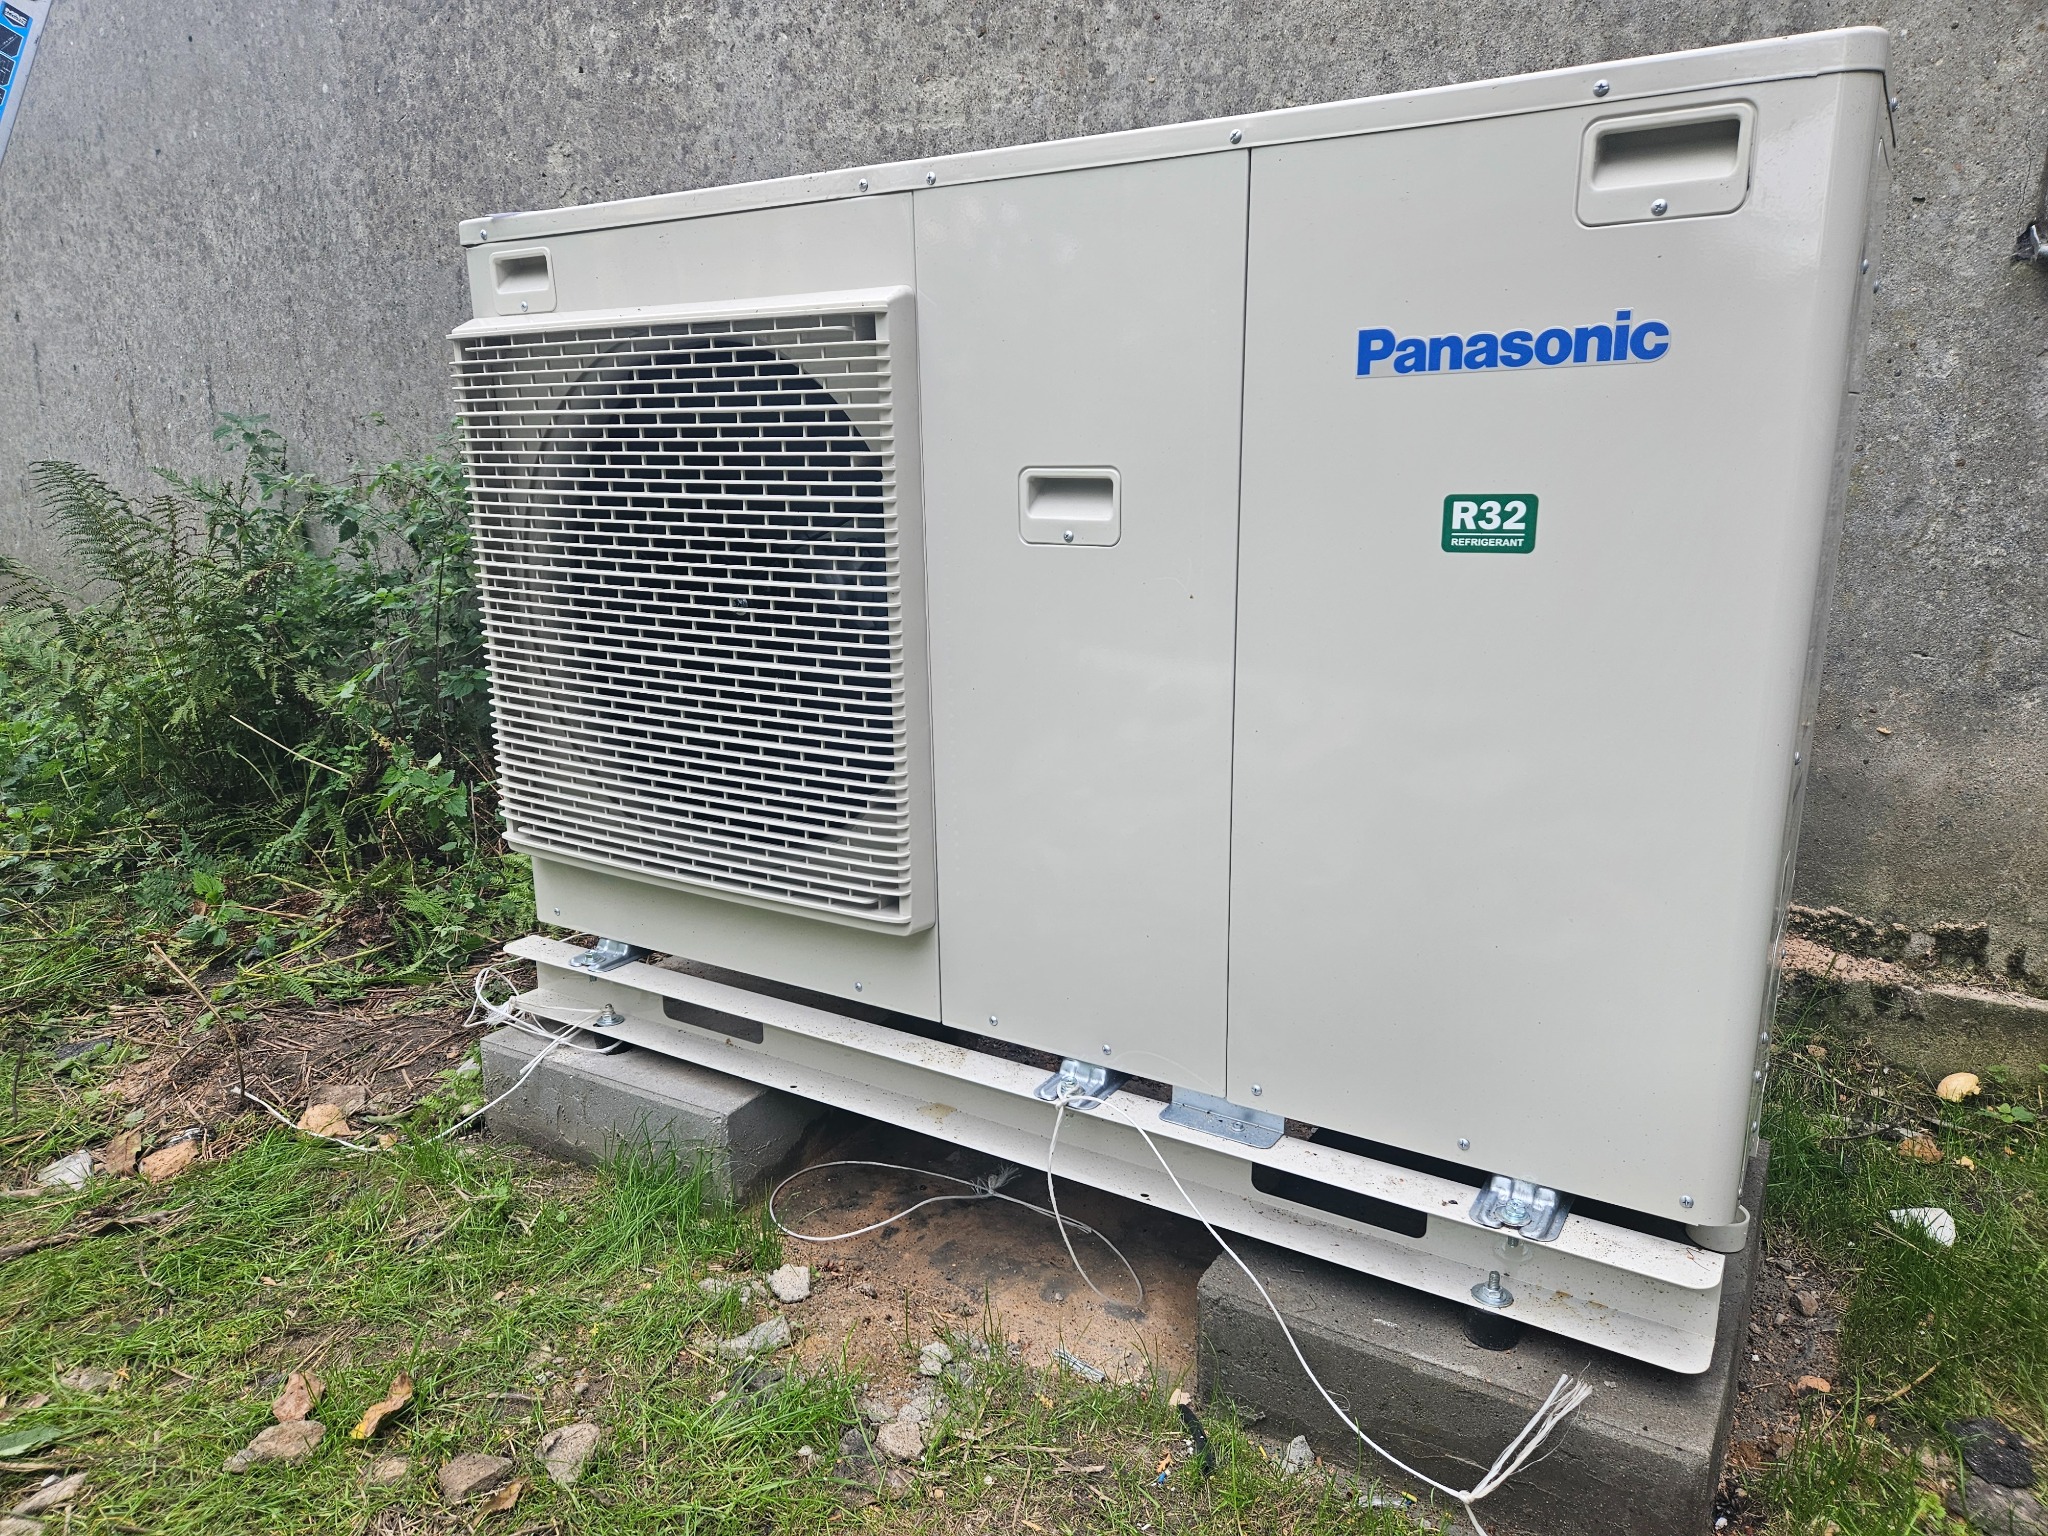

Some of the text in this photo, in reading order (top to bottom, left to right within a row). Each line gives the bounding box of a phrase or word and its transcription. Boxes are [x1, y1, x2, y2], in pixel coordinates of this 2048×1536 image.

[1356, 309, 1670, 376] Panasonic
[1451, 500, 1527, 531] R32
[1450, 537, 1525, 547] REFRIGERANT
